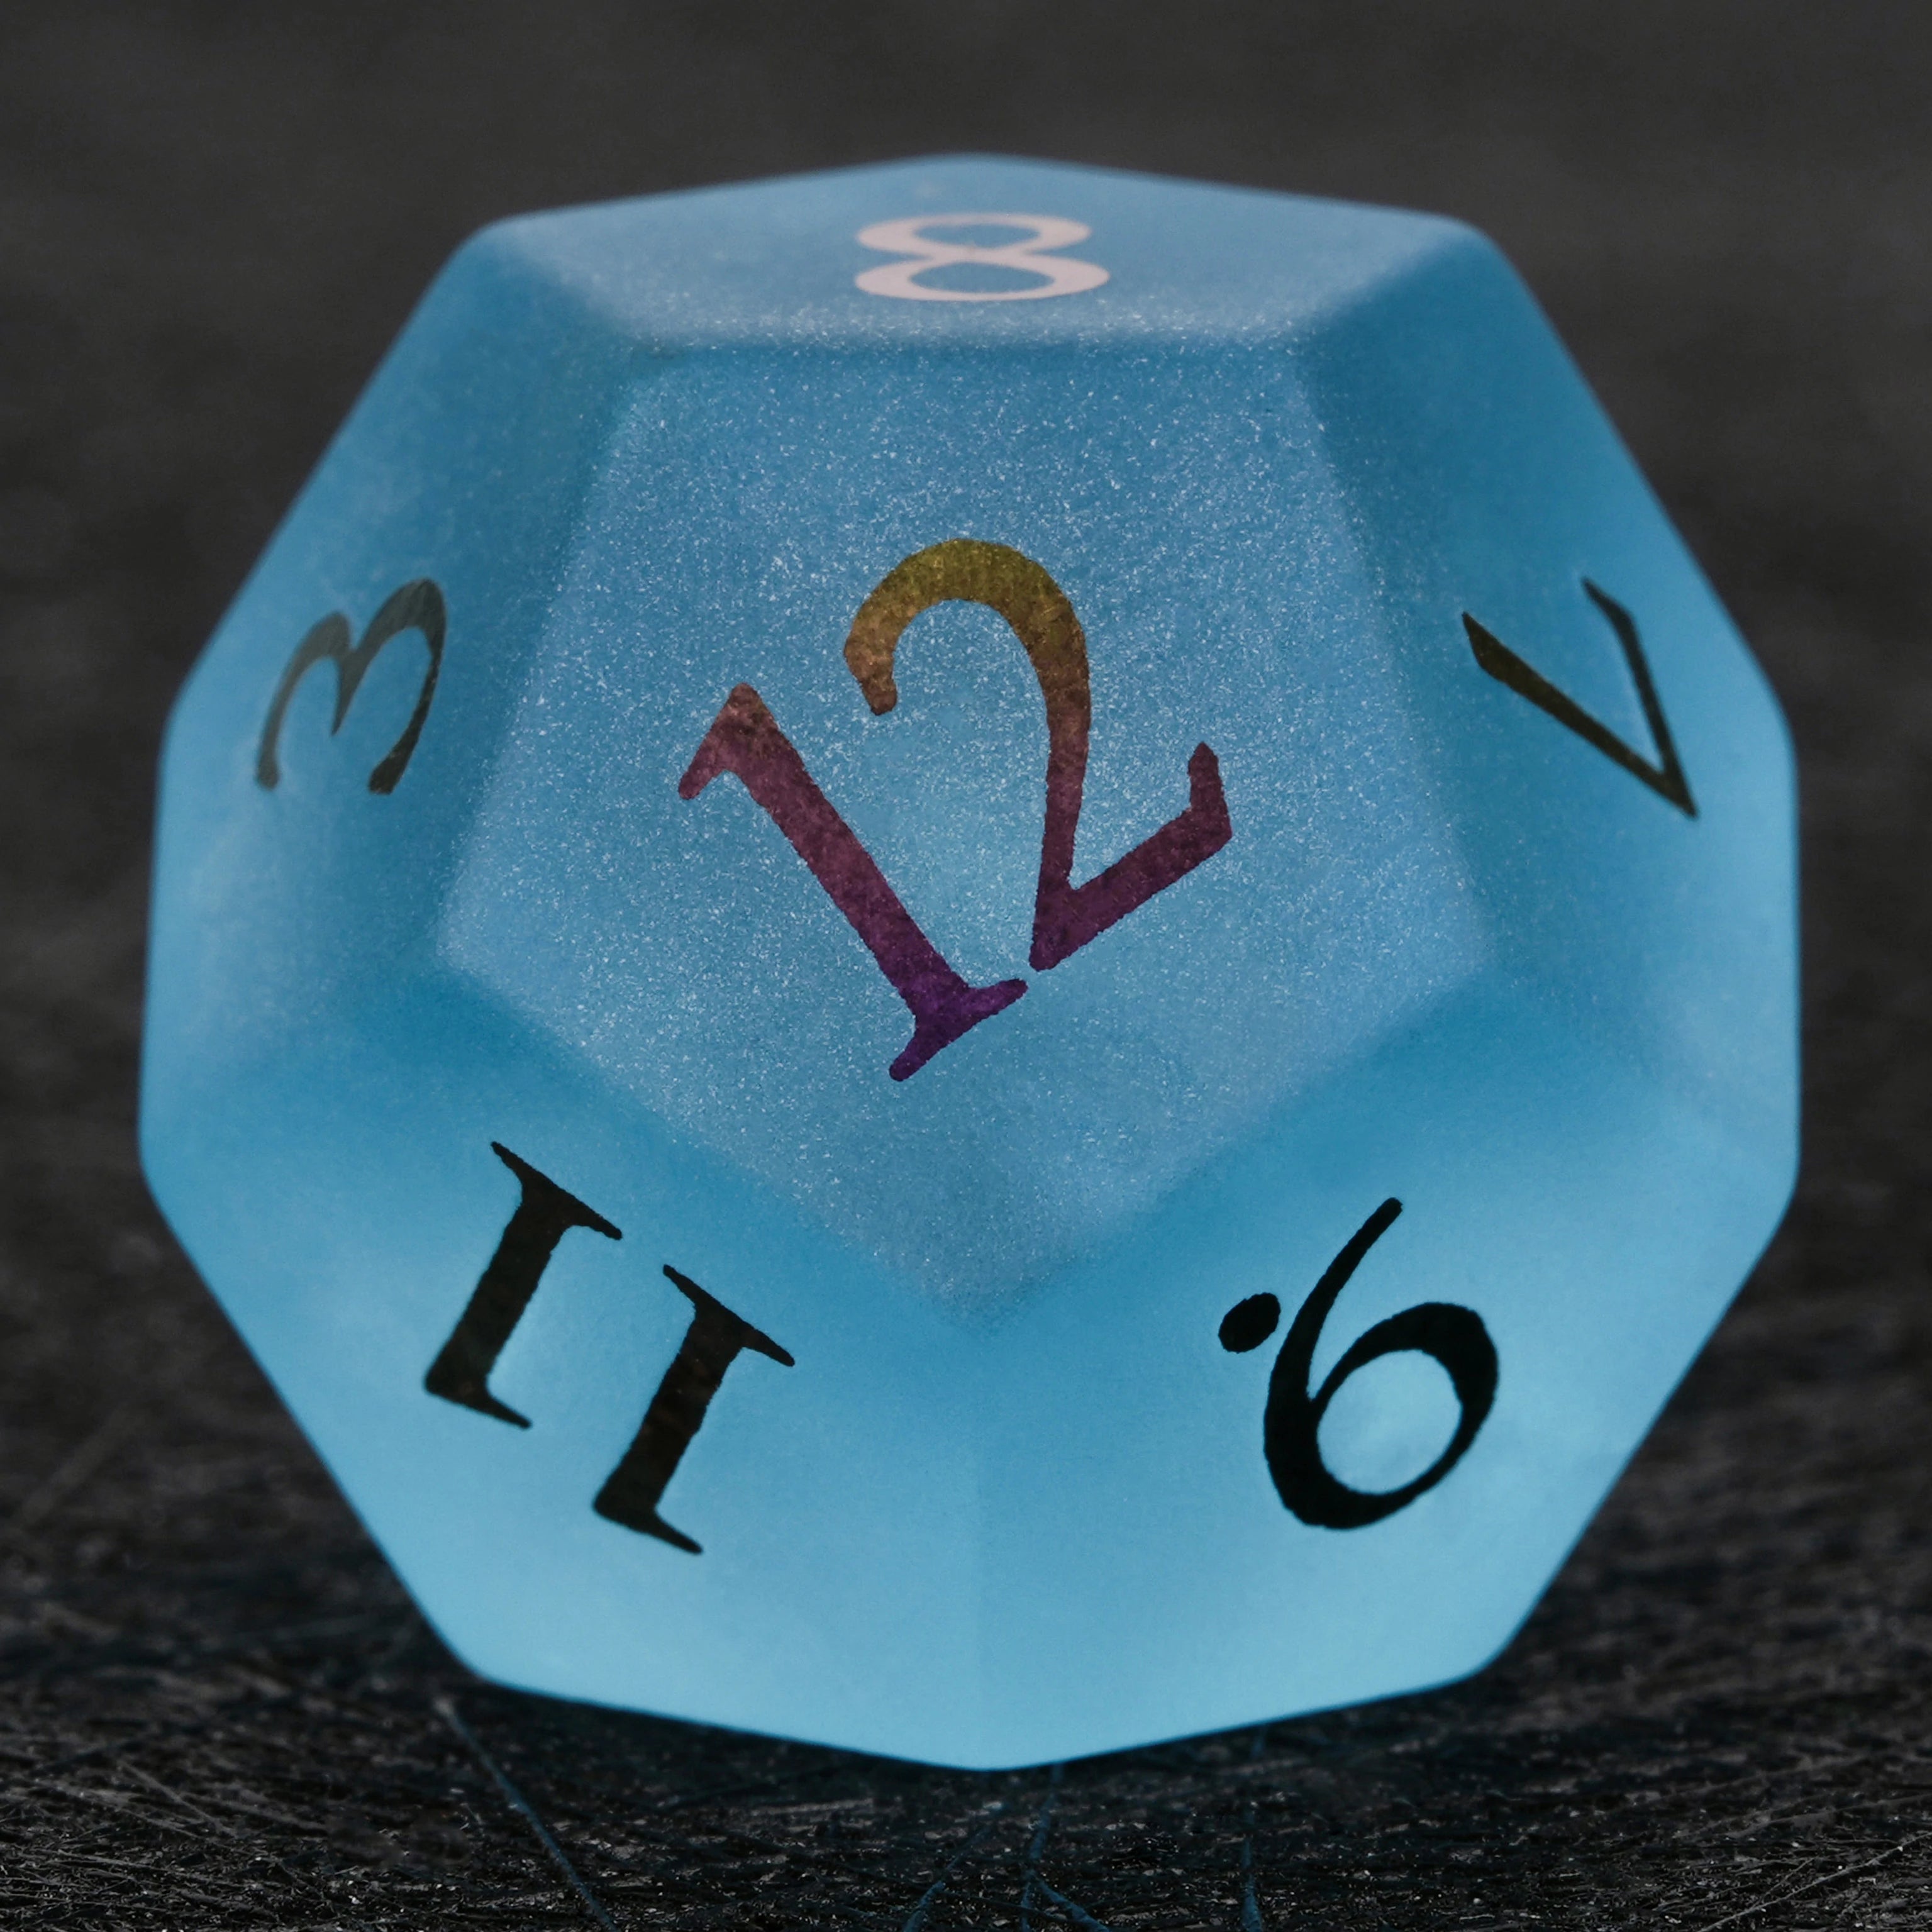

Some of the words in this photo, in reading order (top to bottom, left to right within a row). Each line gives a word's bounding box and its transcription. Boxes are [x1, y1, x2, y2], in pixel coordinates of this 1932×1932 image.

[855, 211, 1110, 301] 8
[256, 577, 447, 795] 3
[678, 538, 1233, 1082] 12
[423, 1141, 796, 1555] 11
